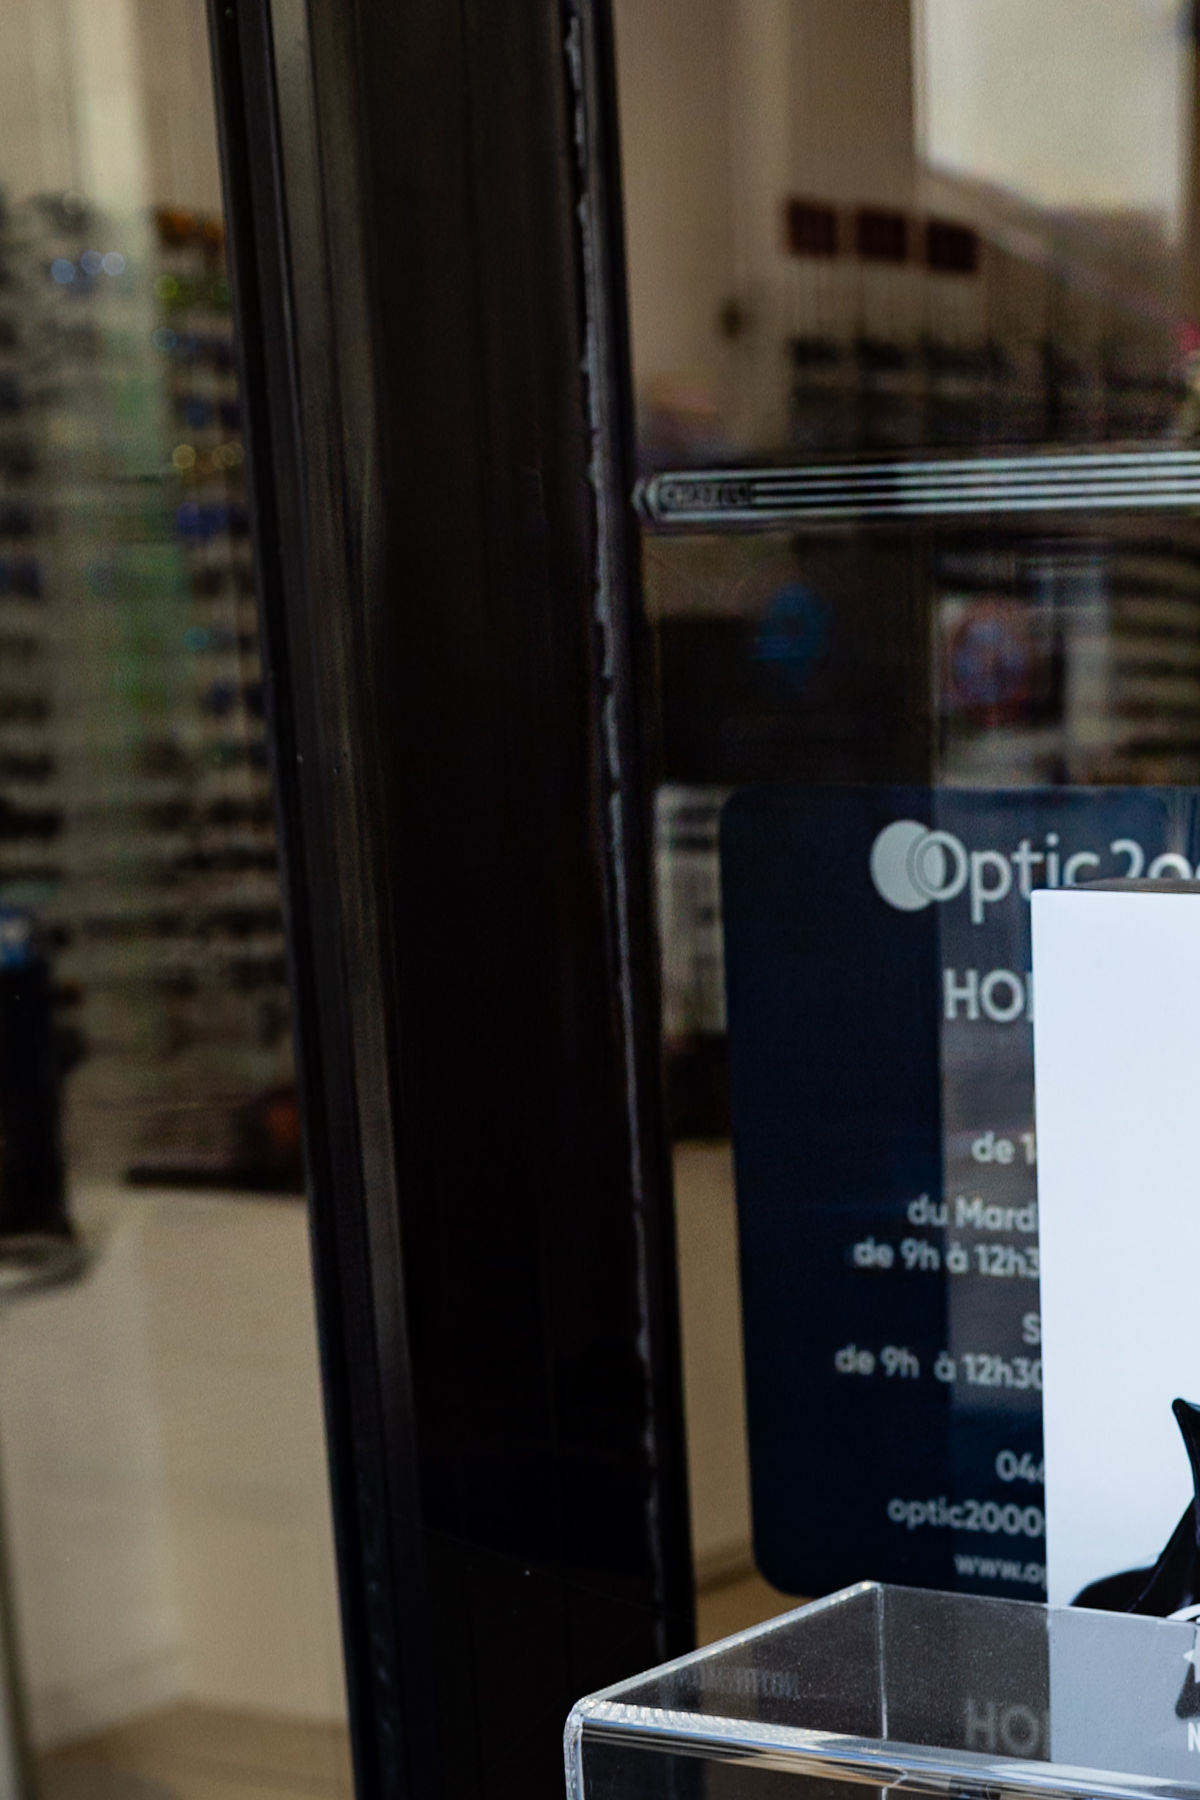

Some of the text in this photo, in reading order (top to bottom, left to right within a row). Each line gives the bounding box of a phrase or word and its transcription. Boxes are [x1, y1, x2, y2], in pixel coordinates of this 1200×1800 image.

[912, 830, 1099, 924] Optic
[942, 967, 1033, 1022] HO
[971, 1130, 1036, 1165] de 1
[907, 1193, 1038, 1233] du Mard
[853, 1235, 895, 1268] de
[901, 1237, 940, 1271] 9h
[976, 1244, 1040, 1279] 12h3
[1022, 1311, 1041, 1345] S
[834, 1344, 876, 1376] de
[881, 1345, 920, 1379] 9h
[887, 1496, 1045, 1538] optic2000
